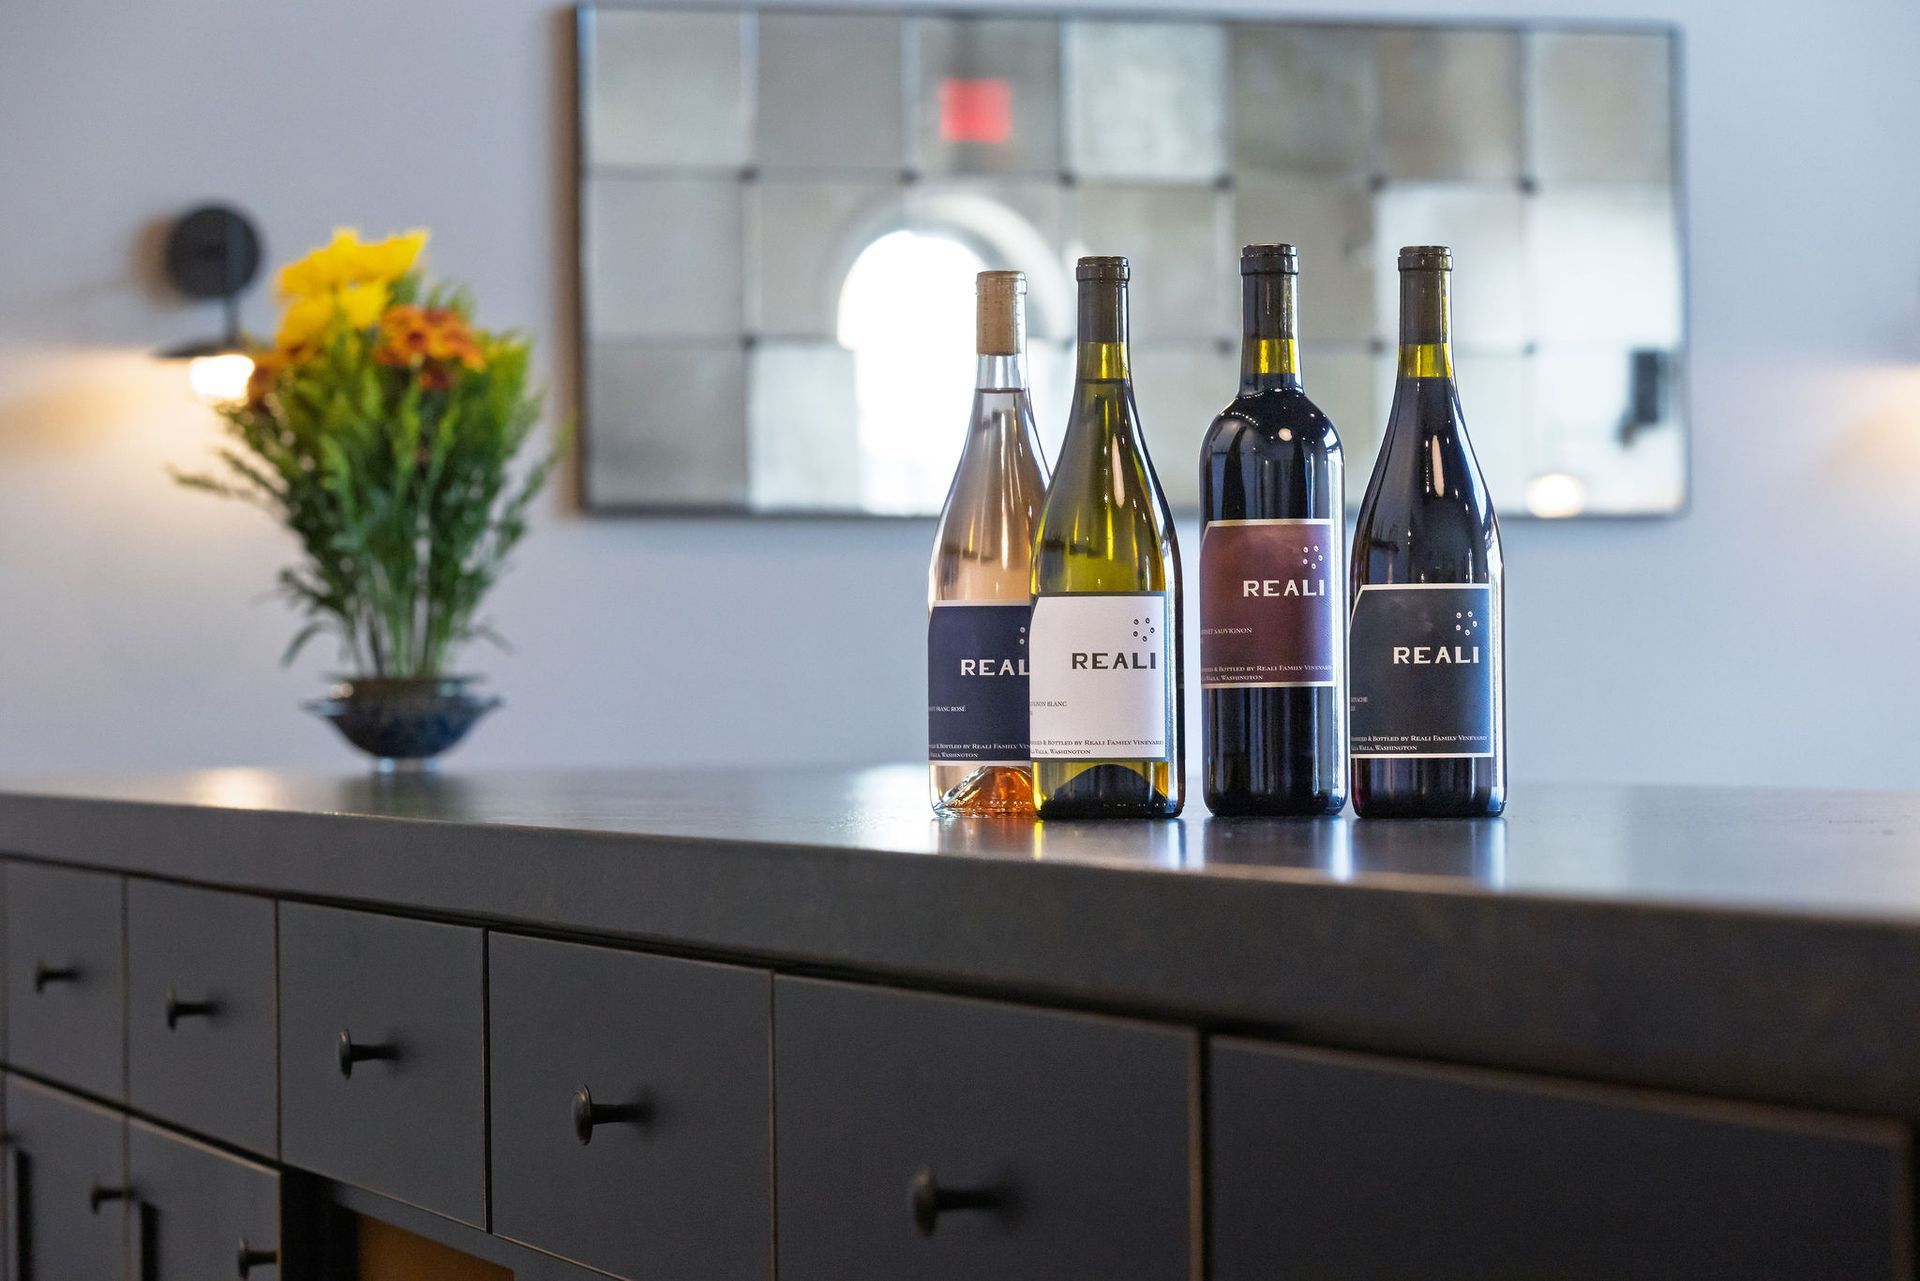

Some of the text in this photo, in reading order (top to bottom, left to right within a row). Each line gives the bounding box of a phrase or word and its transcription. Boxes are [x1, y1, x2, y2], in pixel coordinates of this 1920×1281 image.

[1243, 579, 1325, 597] REALI
[1071, 652, 1156, 669] REALI
[1393, 646, 1480, 664] REALI
[960, 658, 1030, 676] REAL
[1256, 664, 1278, 672] REALI
